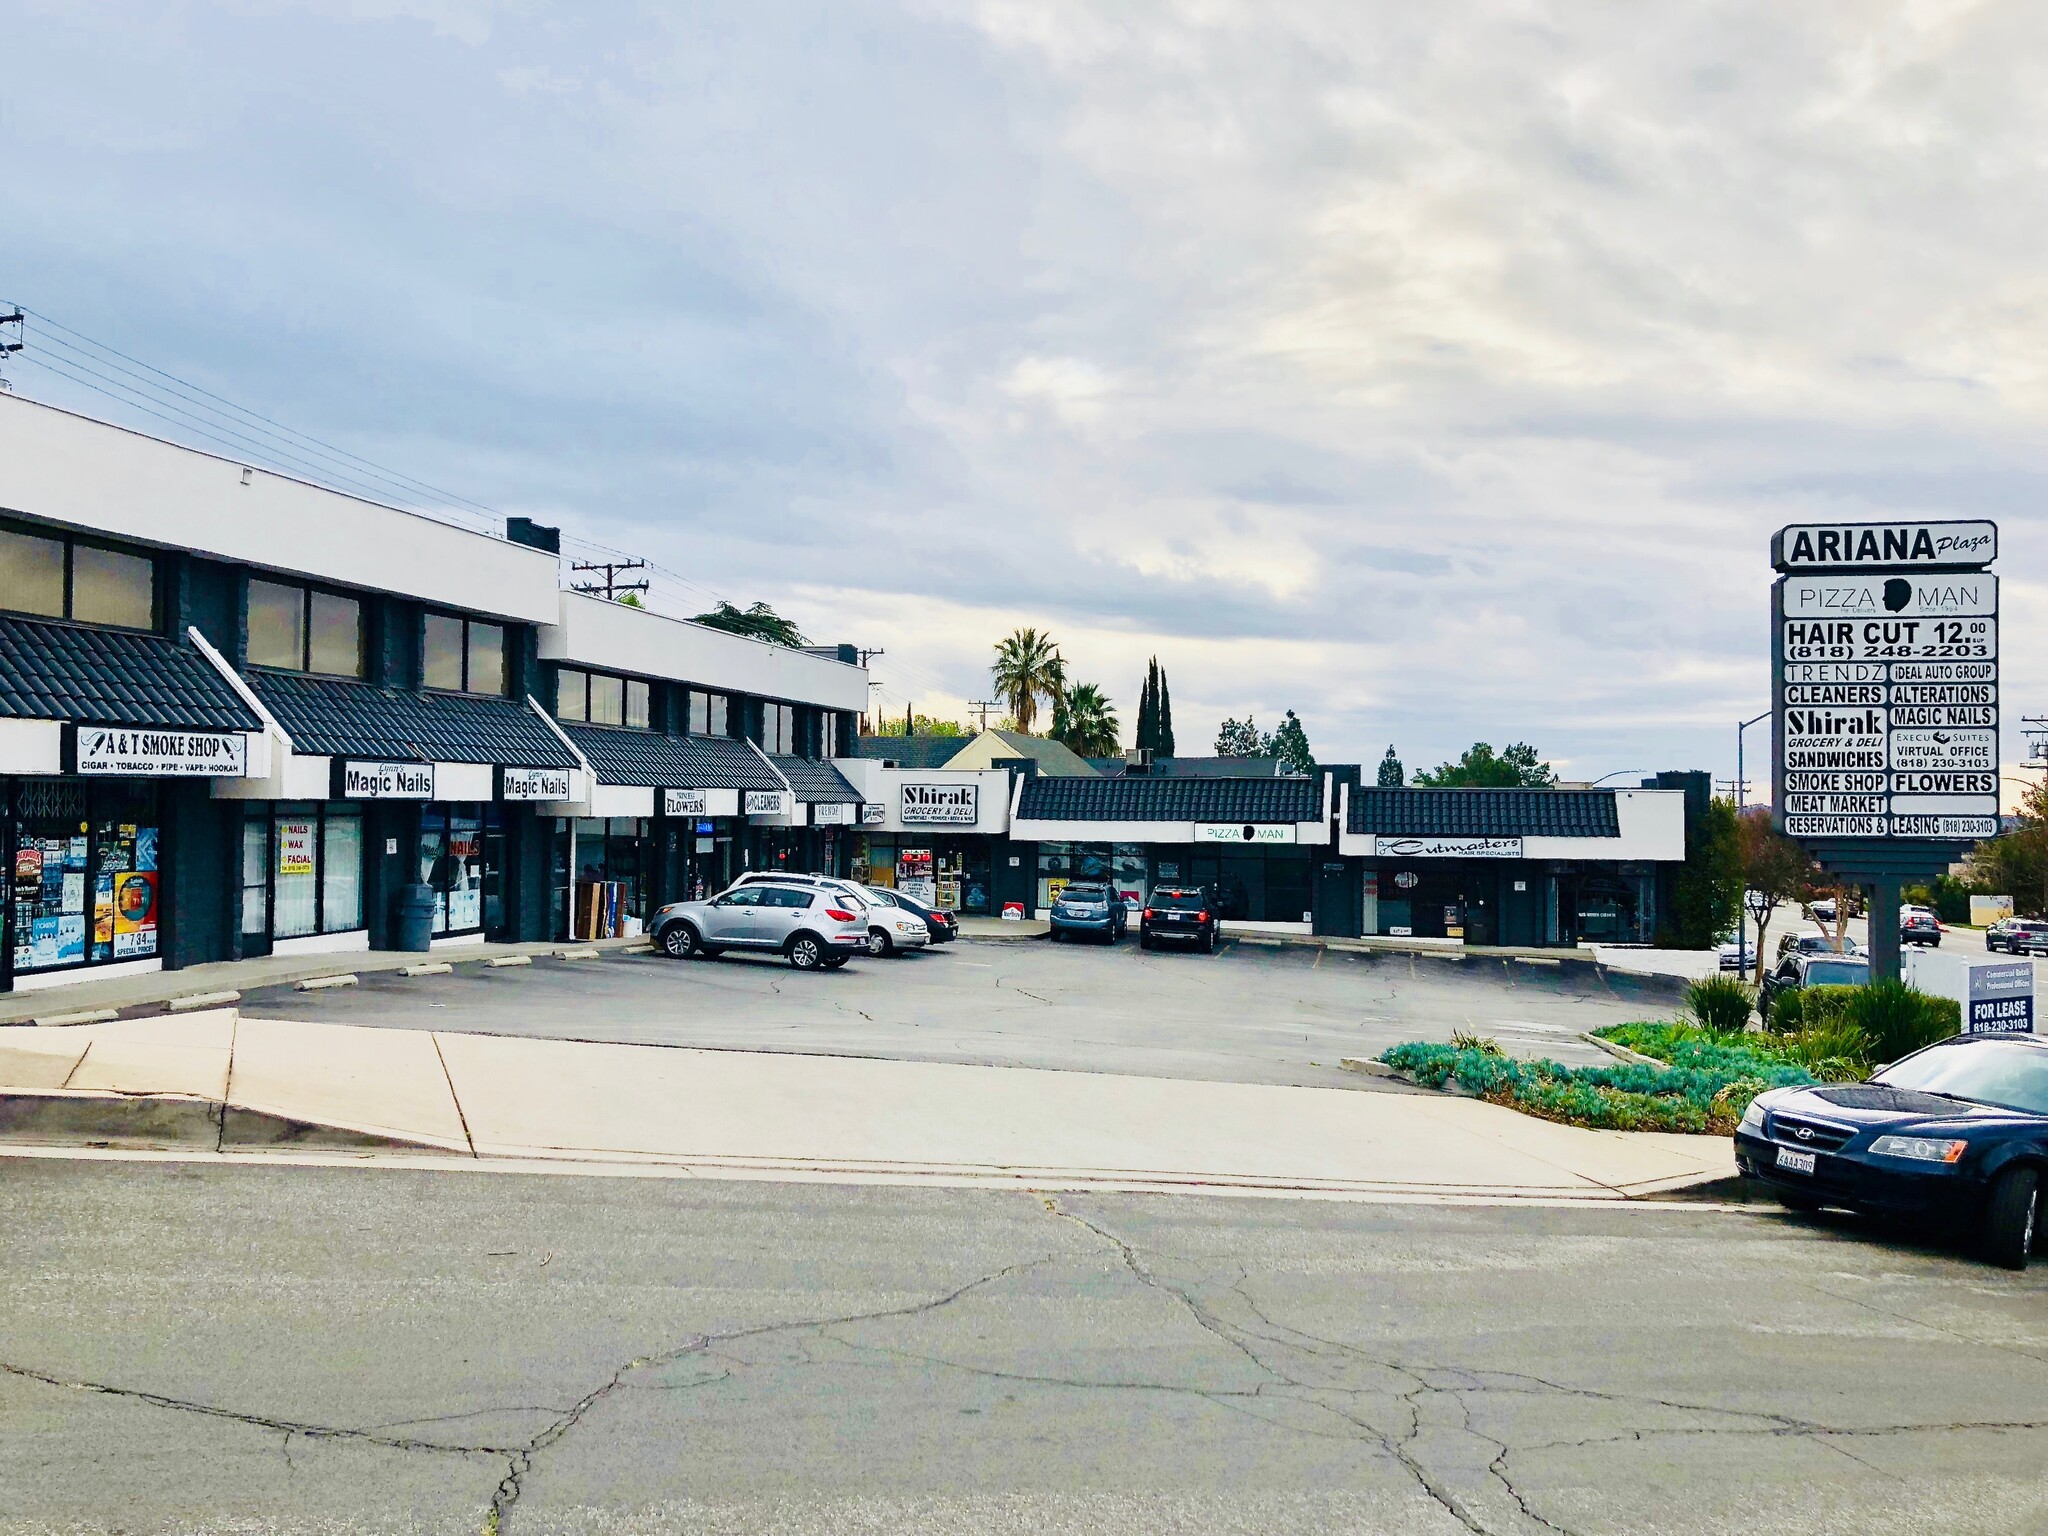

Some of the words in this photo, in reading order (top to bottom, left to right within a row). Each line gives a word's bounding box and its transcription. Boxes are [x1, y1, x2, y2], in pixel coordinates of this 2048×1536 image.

[1790, 529, 1937, 562] ARIANA
[1937, 534, 1991, 555] Plaza
[1800, 588, 1875, 608] PIZZA
[1918, 586, 1978, 606] MAN
[1788, 622, 1854, 645] HAIR
[1863, 622, 1920, 644] CUT
[1789, 646, 1854, 660] (818)
[1863, 645, 1988, 658] 248-2203
[1788, 664, 1885, 681] TRENDZ
[1925, 665, 1952, 679] AUTO
[1955, 664, 1991, 679] GROUP
[1788, 686, 1881, 703] CLEANERS
[1894, 685, 1990, 703] ALTERATIONS
[1788, 710, 1883, 735] Shirak
[1894, 707, 1942, 725] MAGIC
[1947, 707, 1991, 725] NAILS
[106, 732, 115, 754] A
[118, 733, 128, 755] &
[131, 733, 139, 755] T
[142, 734, 184, 756] SMOKE
[187, 735, 220, 757] SHOP
[1788, 738, 1842, 748] GROCERY
[1844, 738, 1853, 747] &
[1856, 737, 1883, 747] DELI
[1896, 733, 1930, 742] EXECU
[1953, 733, 1989, 742] SUITES
[1788, 751, 1883, 768] SANDWICHES
[1897, 746, 1944, 756] VIRTUAL
[1950, 746, 1989, 756] OFFICE
[82, 761, 108, 770] CIGAR
[116, 762, 154, 771] TOBACCO
[161, 763, 178, 771] PIPE
[185, 763, 204, 772] VAPE
[209, 764, 238, 772] HOOKAH
[1896, 758, 1928, 768] (818)
[1932, 758, 1989, 768] 230-3103
[347, 770, 391, 797] Magic
[396, 772, 431, 792] Nails
[505, 775, 538, 797] Magic
[541, 777, 567, 795] Nails
[1789, 773, 1840, 791] SMOKE
[1844, 774, 1884, 791] SHOP
[1895, 774, 1993, 792] FLOWERS
[754, 794, 780, 811] CLEANERS
[905, 787, 973, 805] Shirak
[1791, 795, 1825, 812] MEAT
[1830, 795, 1884, 813] MARKET
[667, 798, 704, 813] FLOWERS
[904, 806, 943, 815] GROCERY
[945, 807, 951, 815] &
[953, 807, 973, 815] DELI
[288, 825, 308, 834] NAILS
[1207, 828, 1240, 839] PIZZA
[1257, 829, 1284, 839] MAN
[1789, 816, 1873, 834] RESERVATIONS
[1876, 817, 1884, 834] &
[1892, 816, 1940, 834] LEASING
[1943, 818, 1960, 833] (818)
[1962, 819, 1993, 833] 230-3103
[288, 840, 303, 848] WAX
[450, 839, 480, 857] NAILS
[1391, 838, 1518, 855] Cutmasters
[287, 854, 311, 864] FACIAL
[117, 947, 137, 956] SPECIAL
[1986, 969, 2015, 979] Commercial
[1974, 1003, 1995, 1020] FOR
[1996, 1000, 2027, 1018] LEASE
[1973, 1018, 2028, 1033] 818-230-3103
